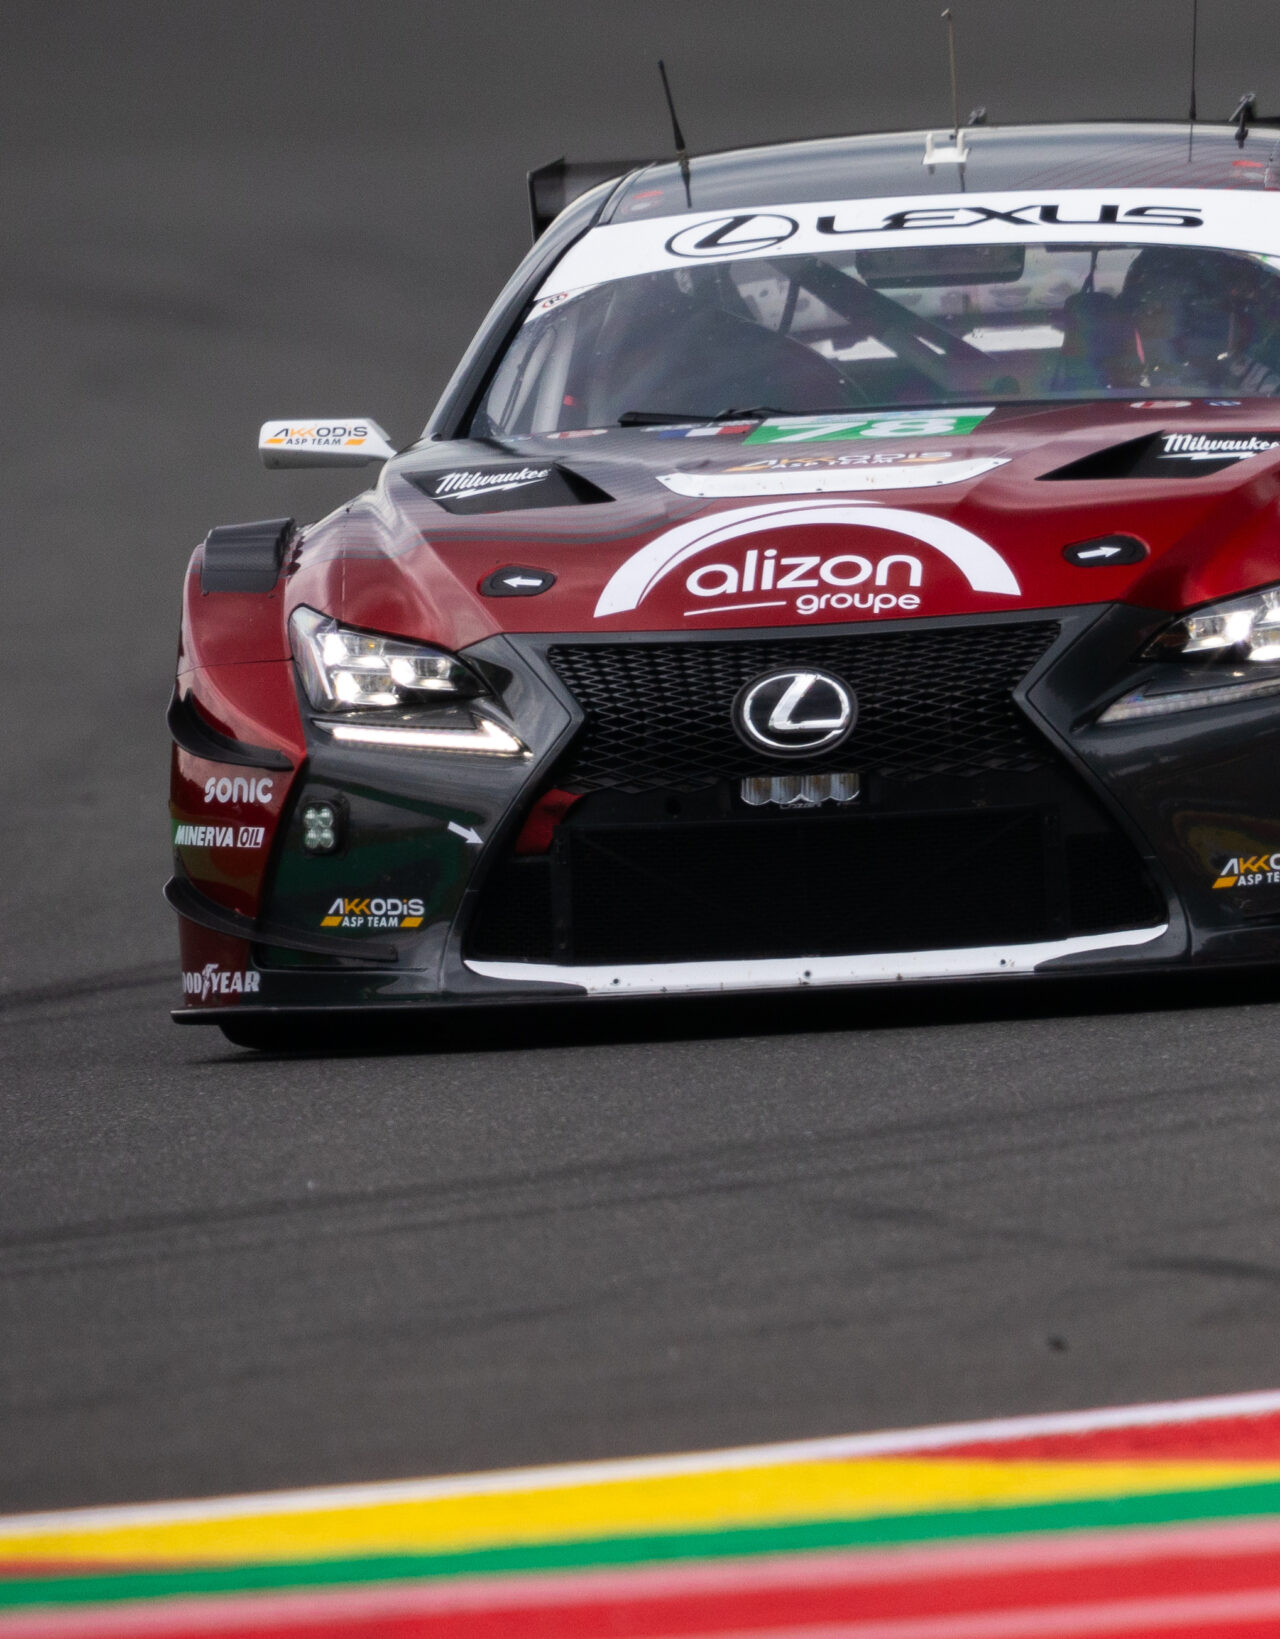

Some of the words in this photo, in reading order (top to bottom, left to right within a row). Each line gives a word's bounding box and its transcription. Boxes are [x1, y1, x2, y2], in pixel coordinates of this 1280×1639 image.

[816, 204, 1204, 235] LEXUS
[768, 418, 957, 443] 78
[1161, 433, 1280, 452] Milwaukee
[436, 467, 549, 494] Milwaukee
[685, 548, 923, 597] alizon
[796, 593, 921, 616] groupe
[174, 825, 234, 847] MINERVA
[238, 827, 265, 848] OIL
[1237, 874, 1262, 887] ASP
[342, 916, 364, 927] ASP
[368, 917, 398, 927] TEAM
